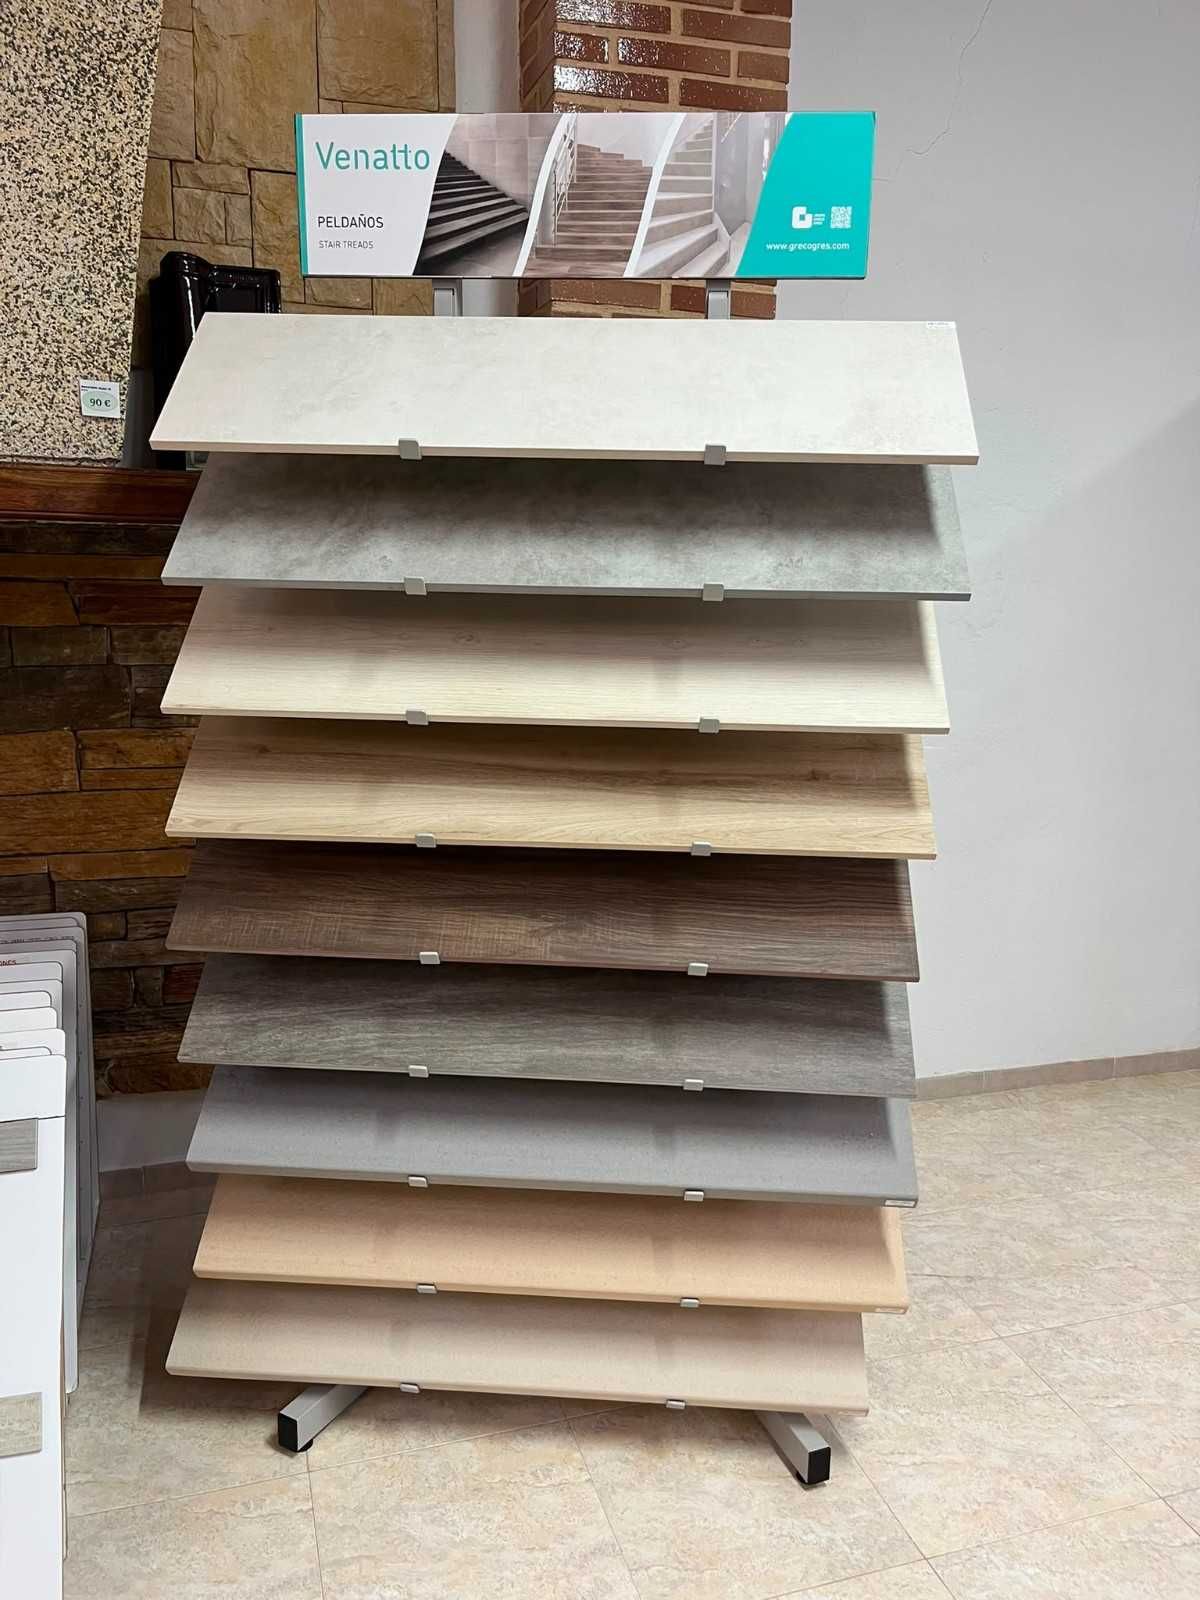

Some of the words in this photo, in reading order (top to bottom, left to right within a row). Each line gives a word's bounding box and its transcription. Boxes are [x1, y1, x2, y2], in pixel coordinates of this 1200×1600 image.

[315, 141, 430, 170] Venatto
[318, 213, 384, 228] PELDAÑOS
[319, 240, 341, 249] STAIR
[342, 240, 374, 249] TREADS
[766, 242, 850, 252] www.grecogres.com
[89, 398, 102, 407] 90
